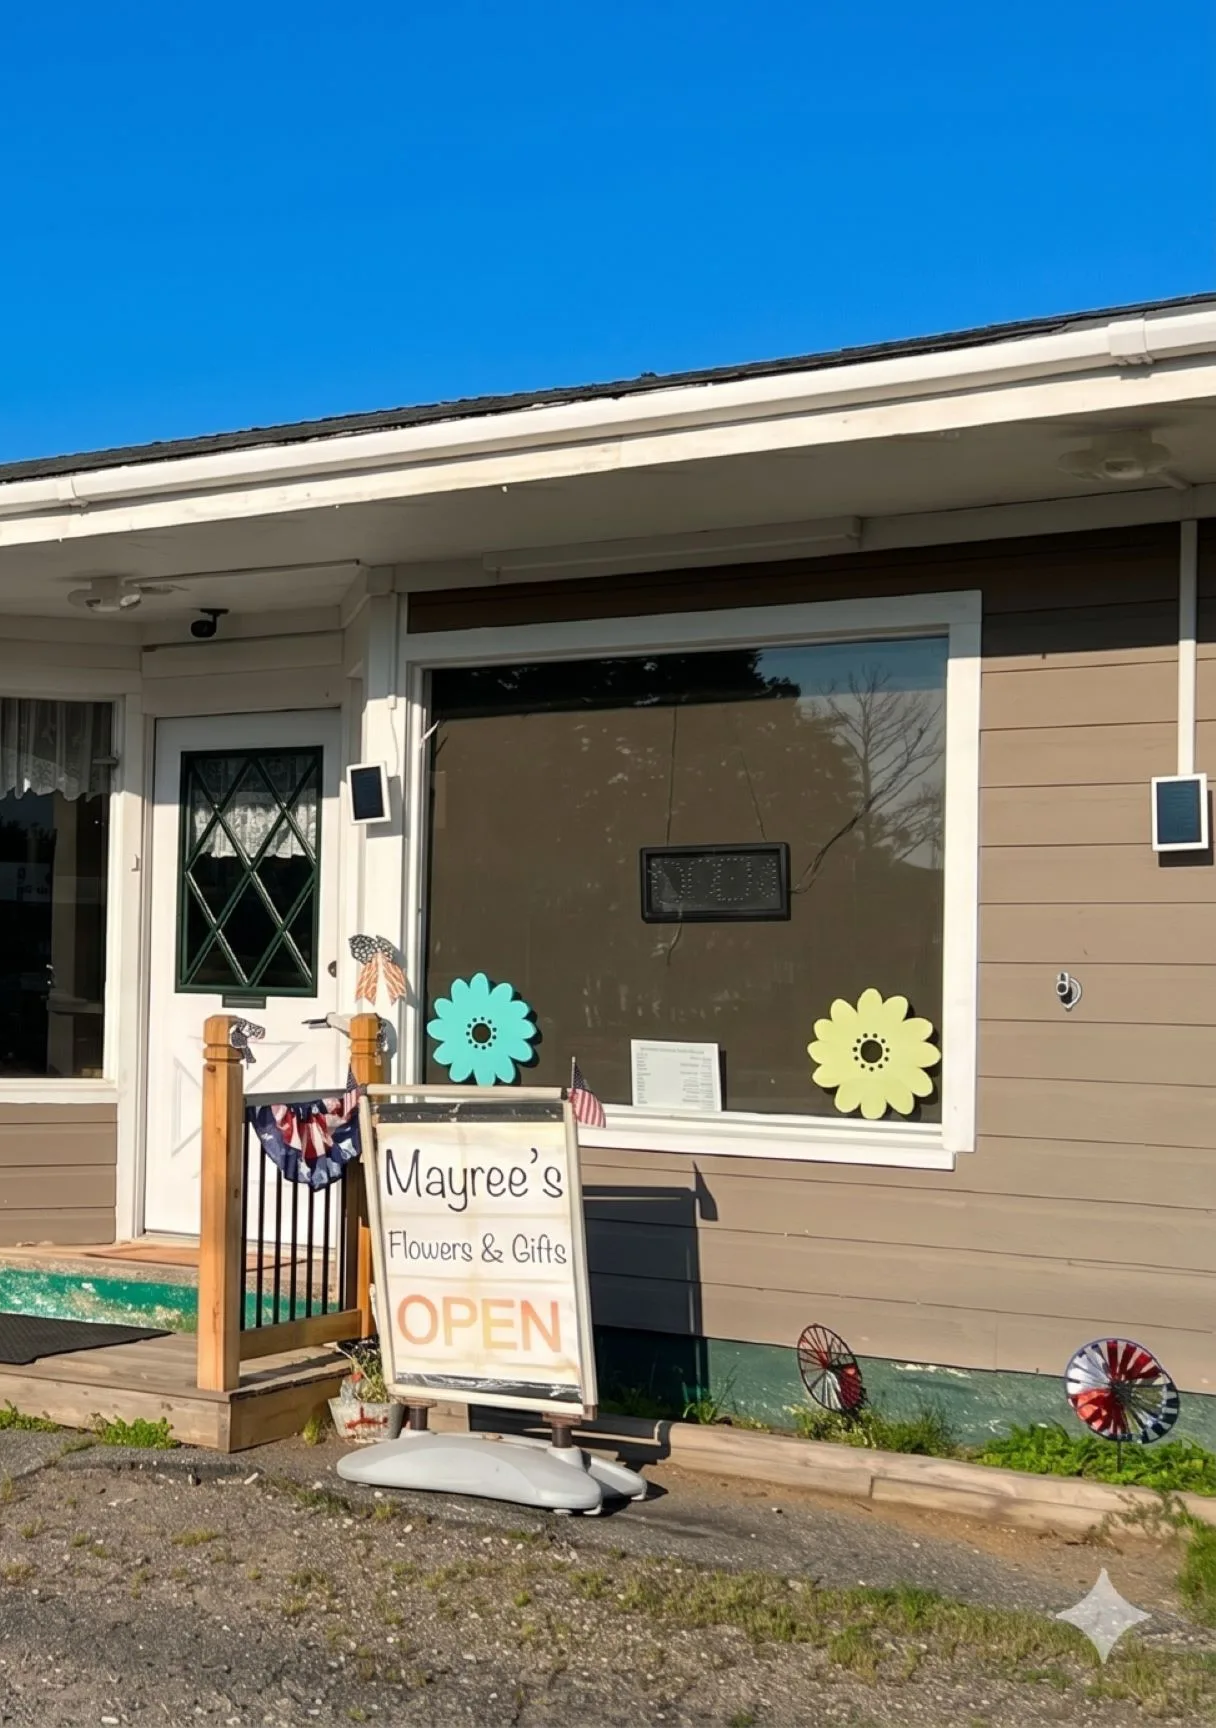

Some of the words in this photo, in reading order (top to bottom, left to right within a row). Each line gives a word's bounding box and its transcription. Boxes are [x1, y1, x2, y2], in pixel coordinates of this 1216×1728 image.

[385, 1147, 564, 1212] Mayree's
[388, 1230, 473, 1263] Flowers
[481, 1232, 504, 1264] &
[512, 1234, 567, 1265] Gifts
[397, 1294, 562, 1353] OPEN
